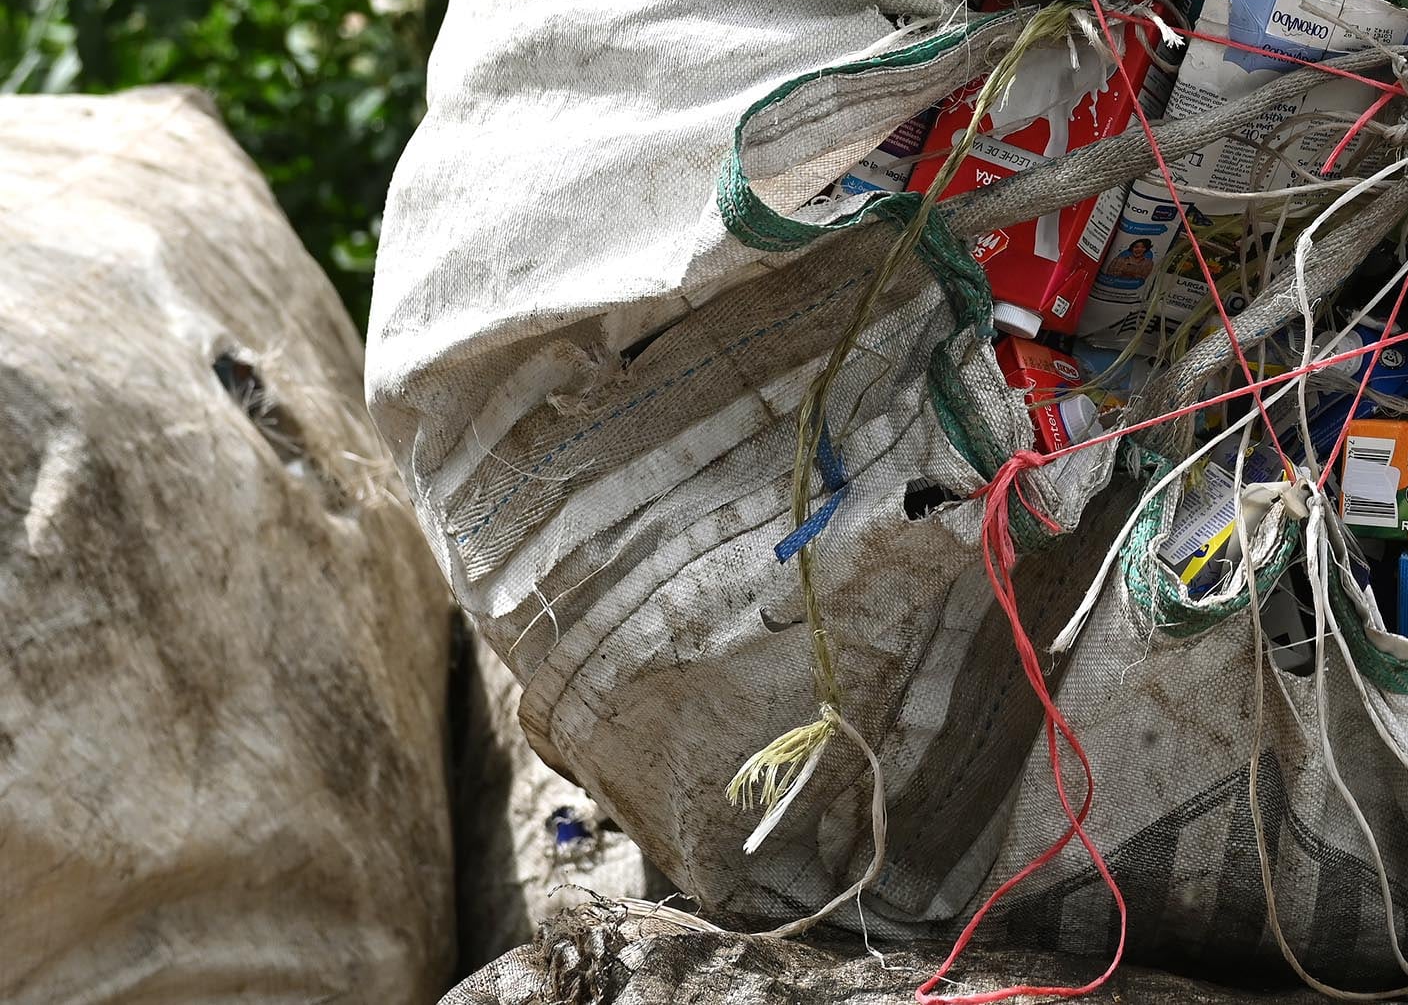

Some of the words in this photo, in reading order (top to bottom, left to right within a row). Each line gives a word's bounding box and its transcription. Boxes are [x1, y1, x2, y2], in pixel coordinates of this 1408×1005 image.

[1271, 9, 1330, 40] CORONADO
[1199, 88, 1221, 99] envase
[1255, 122, 1274, 132] más
[1240, 129, 1259, 141] 40
[984, 144, 998, 155] DE
[998, 151, 1031, 170] LECHE
[1131, 204, 1149, 216] con
[1176, 278, 1203, 292] LARGA
[1167, 293, 1192, 306] LECHE
